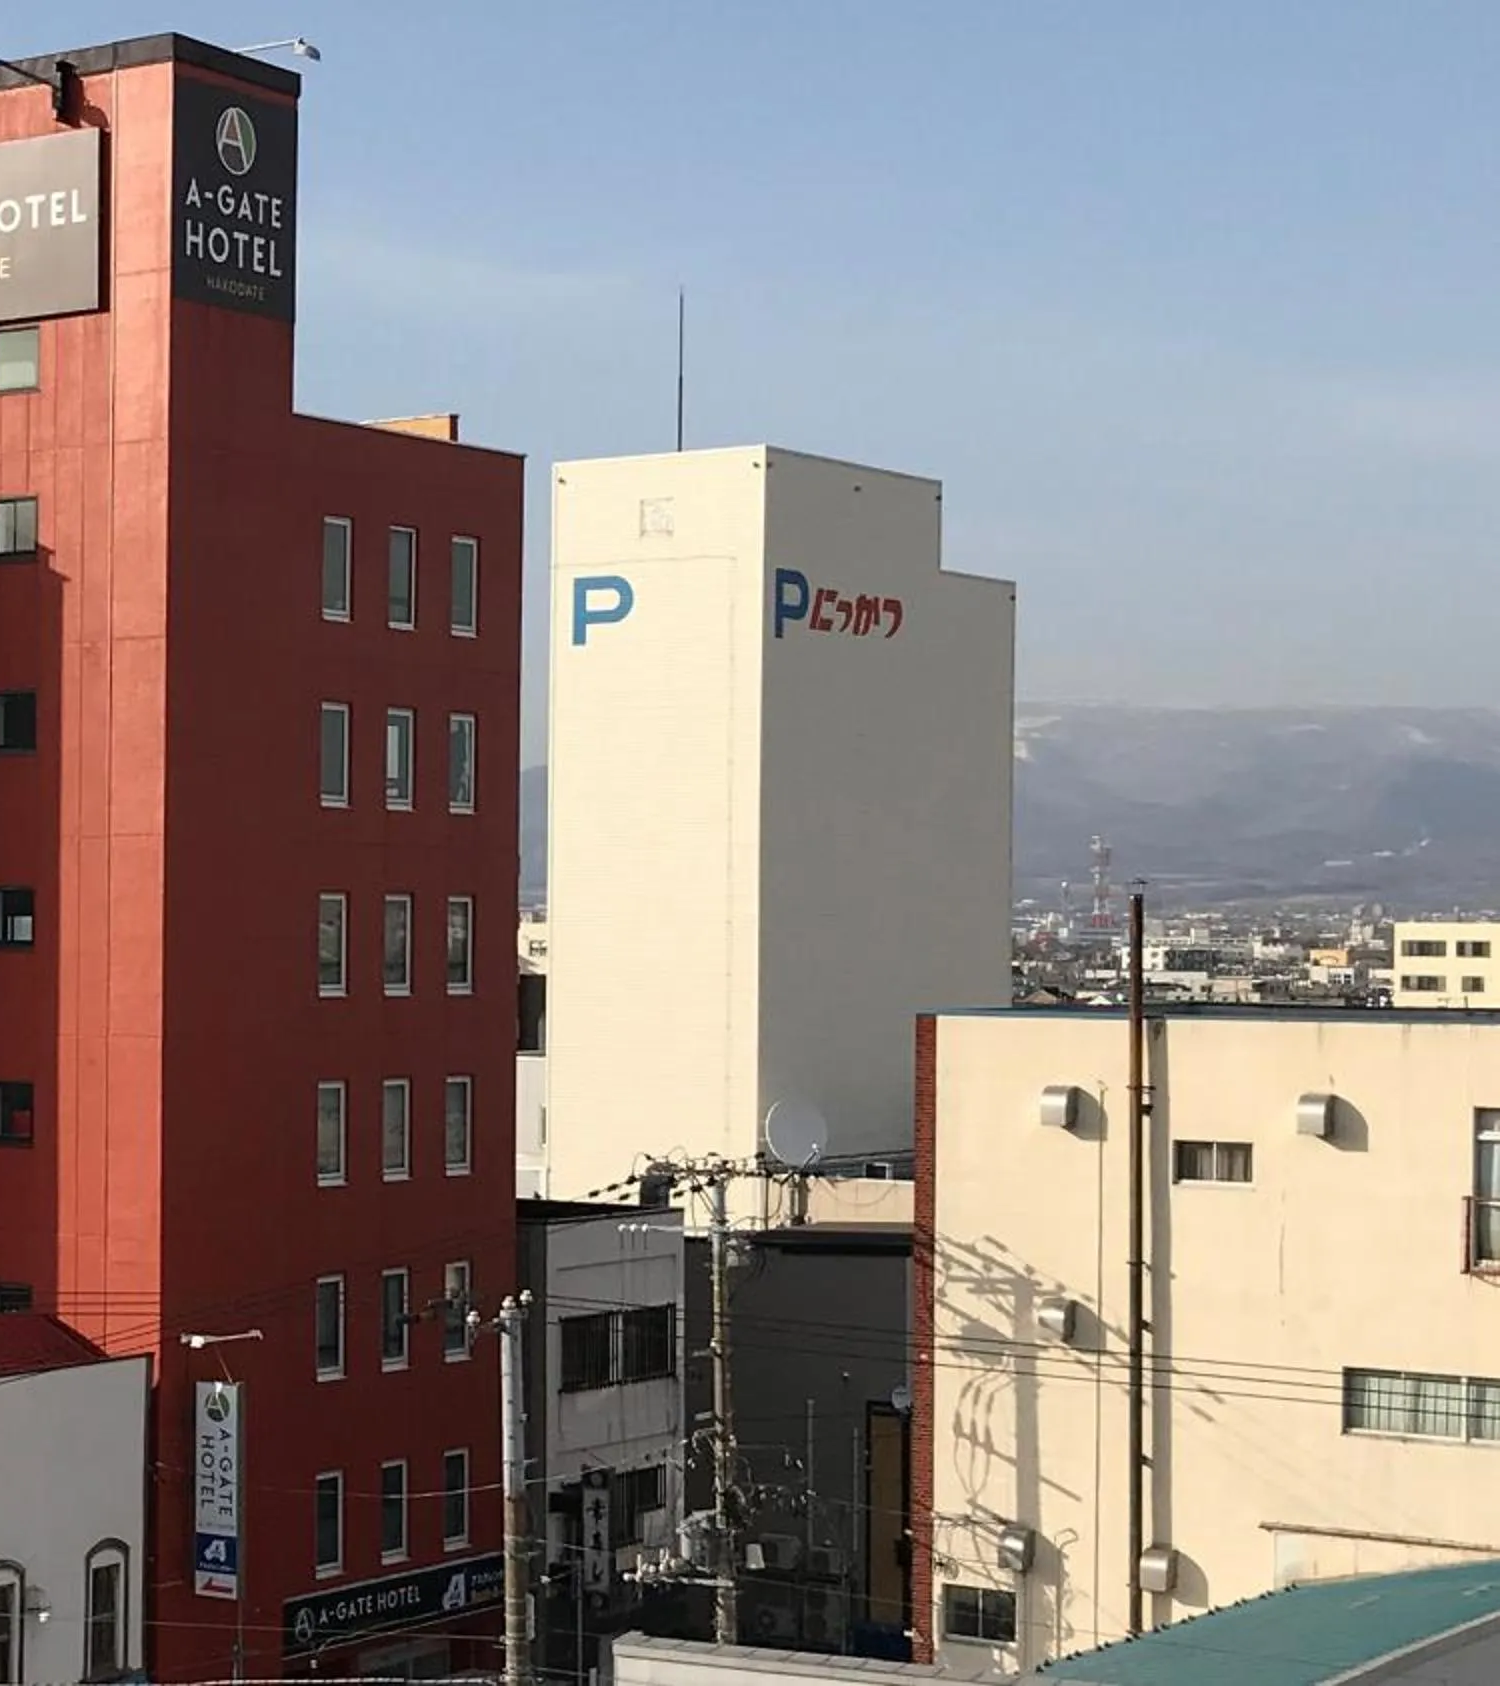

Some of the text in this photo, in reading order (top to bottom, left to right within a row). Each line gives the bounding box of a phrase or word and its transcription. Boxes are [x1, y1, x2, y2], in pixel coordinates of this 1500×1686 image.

[186, 178, 282, 228] A-GATE
[186, 220, 282, 277] HOTEL
[572, 575, 634, 645] P
[774, 568, 903, 639] P にっかつ
[201, 1435, 215, 1509] HOTEL
[219, 1428, 233, 1517] A-GATE
[319, 1596, 373, 1624] A-GATE
[377, 1585, 422, 1613] HOTEL
